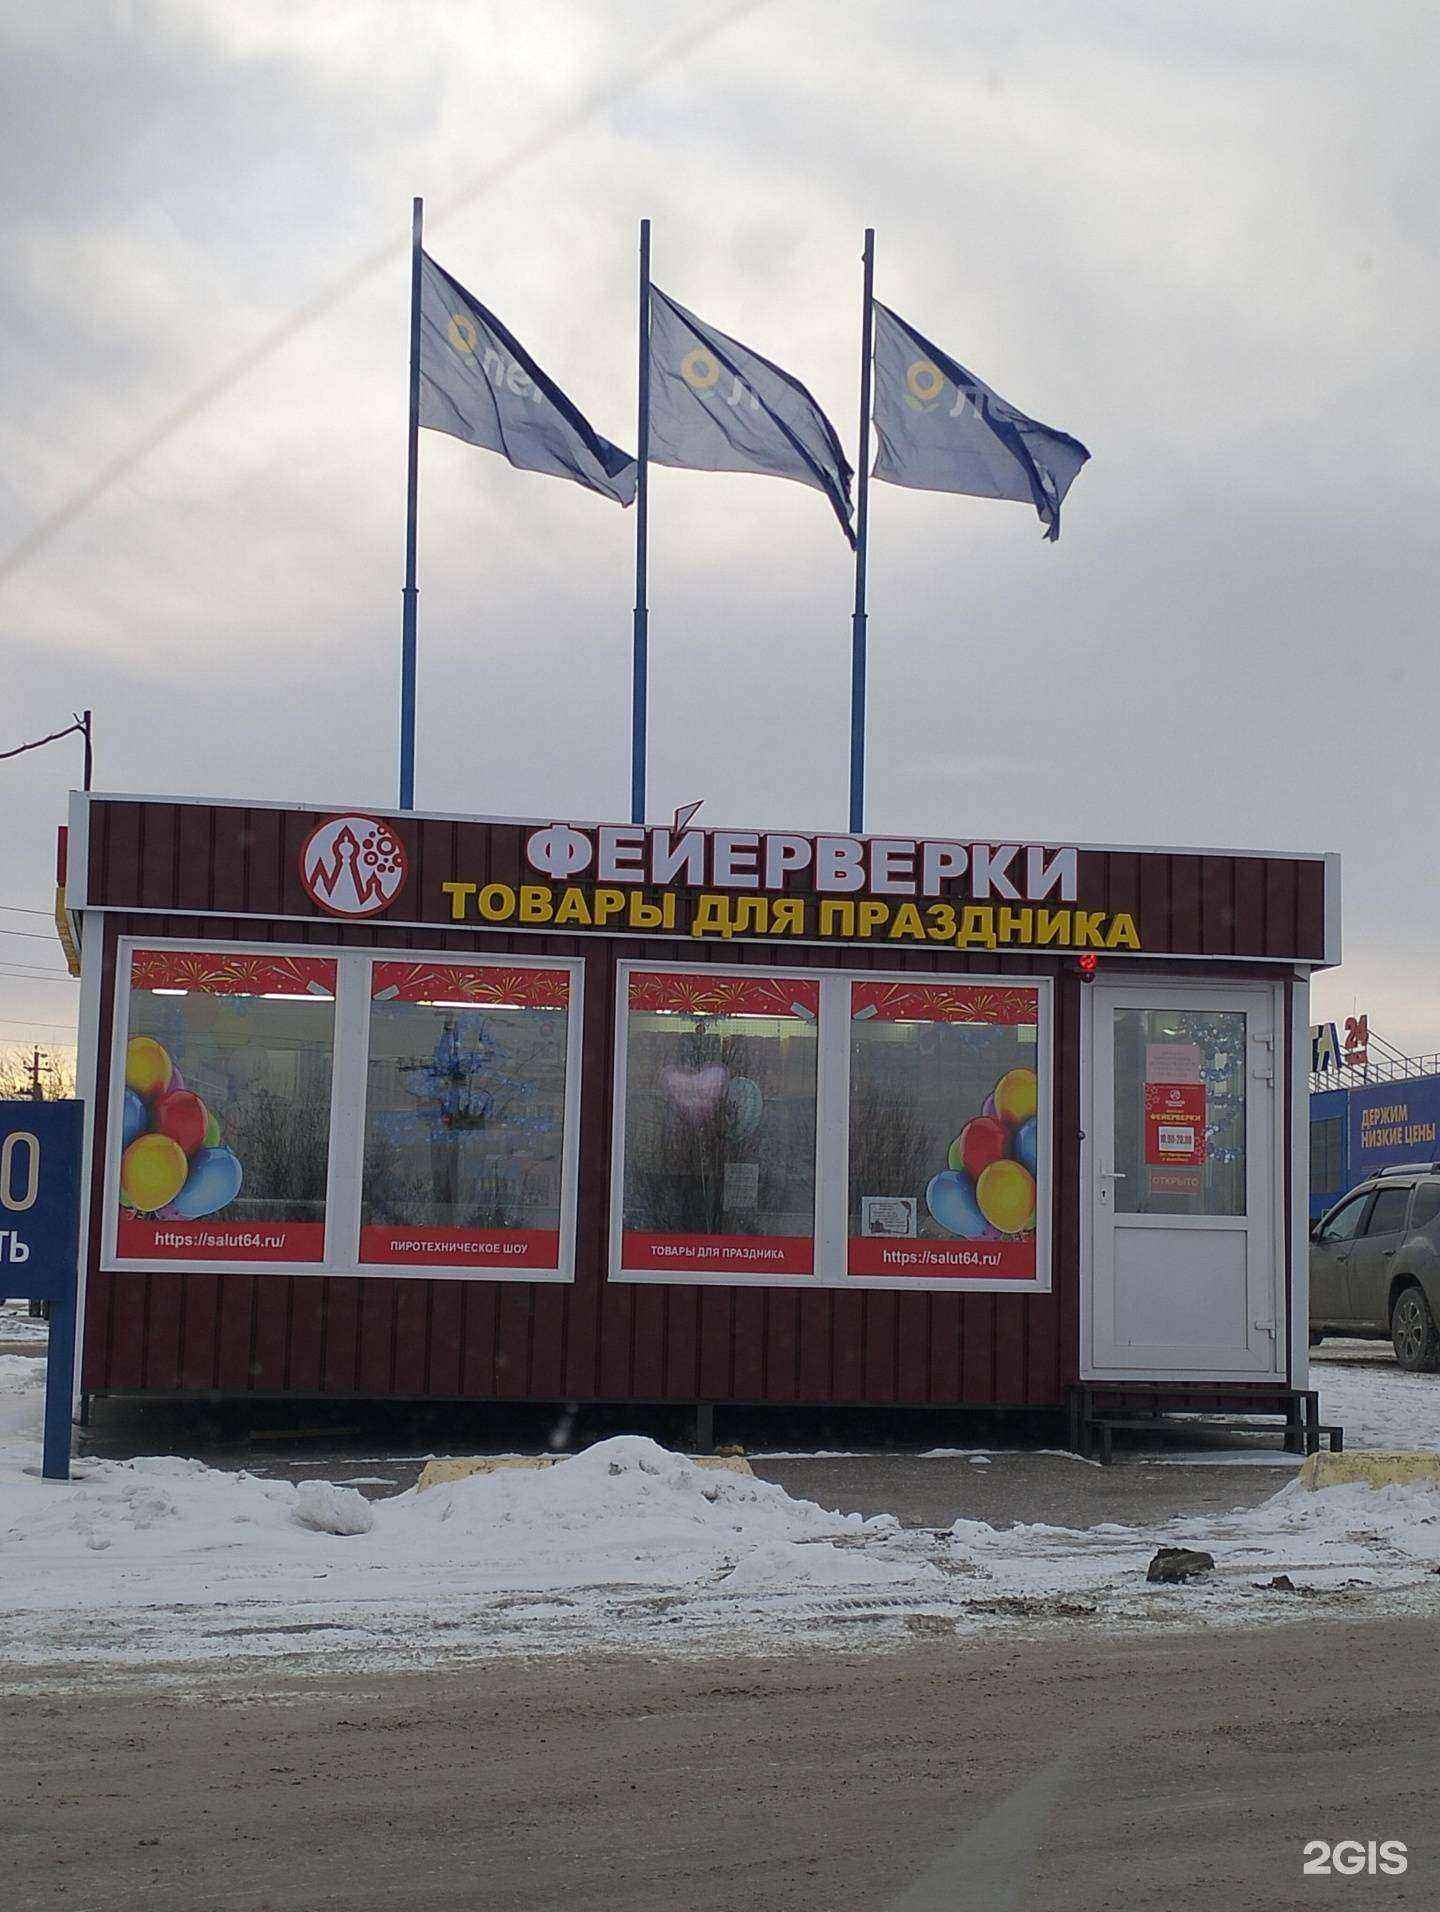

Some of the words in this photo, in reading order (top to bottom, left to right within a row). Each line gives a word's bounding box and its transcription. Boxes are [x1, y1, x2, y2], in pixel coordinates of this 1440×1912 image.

[526, 800, 1080, 902] ФЕЙЕРВЕРКИ
[441, 882, 676, 929] ТОВАРЫ
[692, 894, 805, 939] ДЛЯ
[820, 899, 1141, 949] ПРАЗДНИКА
[1361, 1104, 1408, 1130] ДЕРЖИМ
[1361, 1126, 1403, 1149] НИЗКИЕ
[1405, 1122, 1436, 1147] ЦЕНЫ
[1152, 1176, 1199, 1186] ОТКРЫТО
[154, 1231, 286, 1250] https://salut64.ru/
[390, 1240, 500, 1254] ПИРОТЕХНИЧЕСКОЕ
[502, 1243, 528, 1255] ШОУ
[650, 1244, 696, 1257] ТОВАРЫ
[697, 1247, 721, 1259] ДЛЯ
[722, 1247, 785, 1260] ПРАЗДНИКА
[882, 1248, 1002, 1267] https://salut64.ru/
